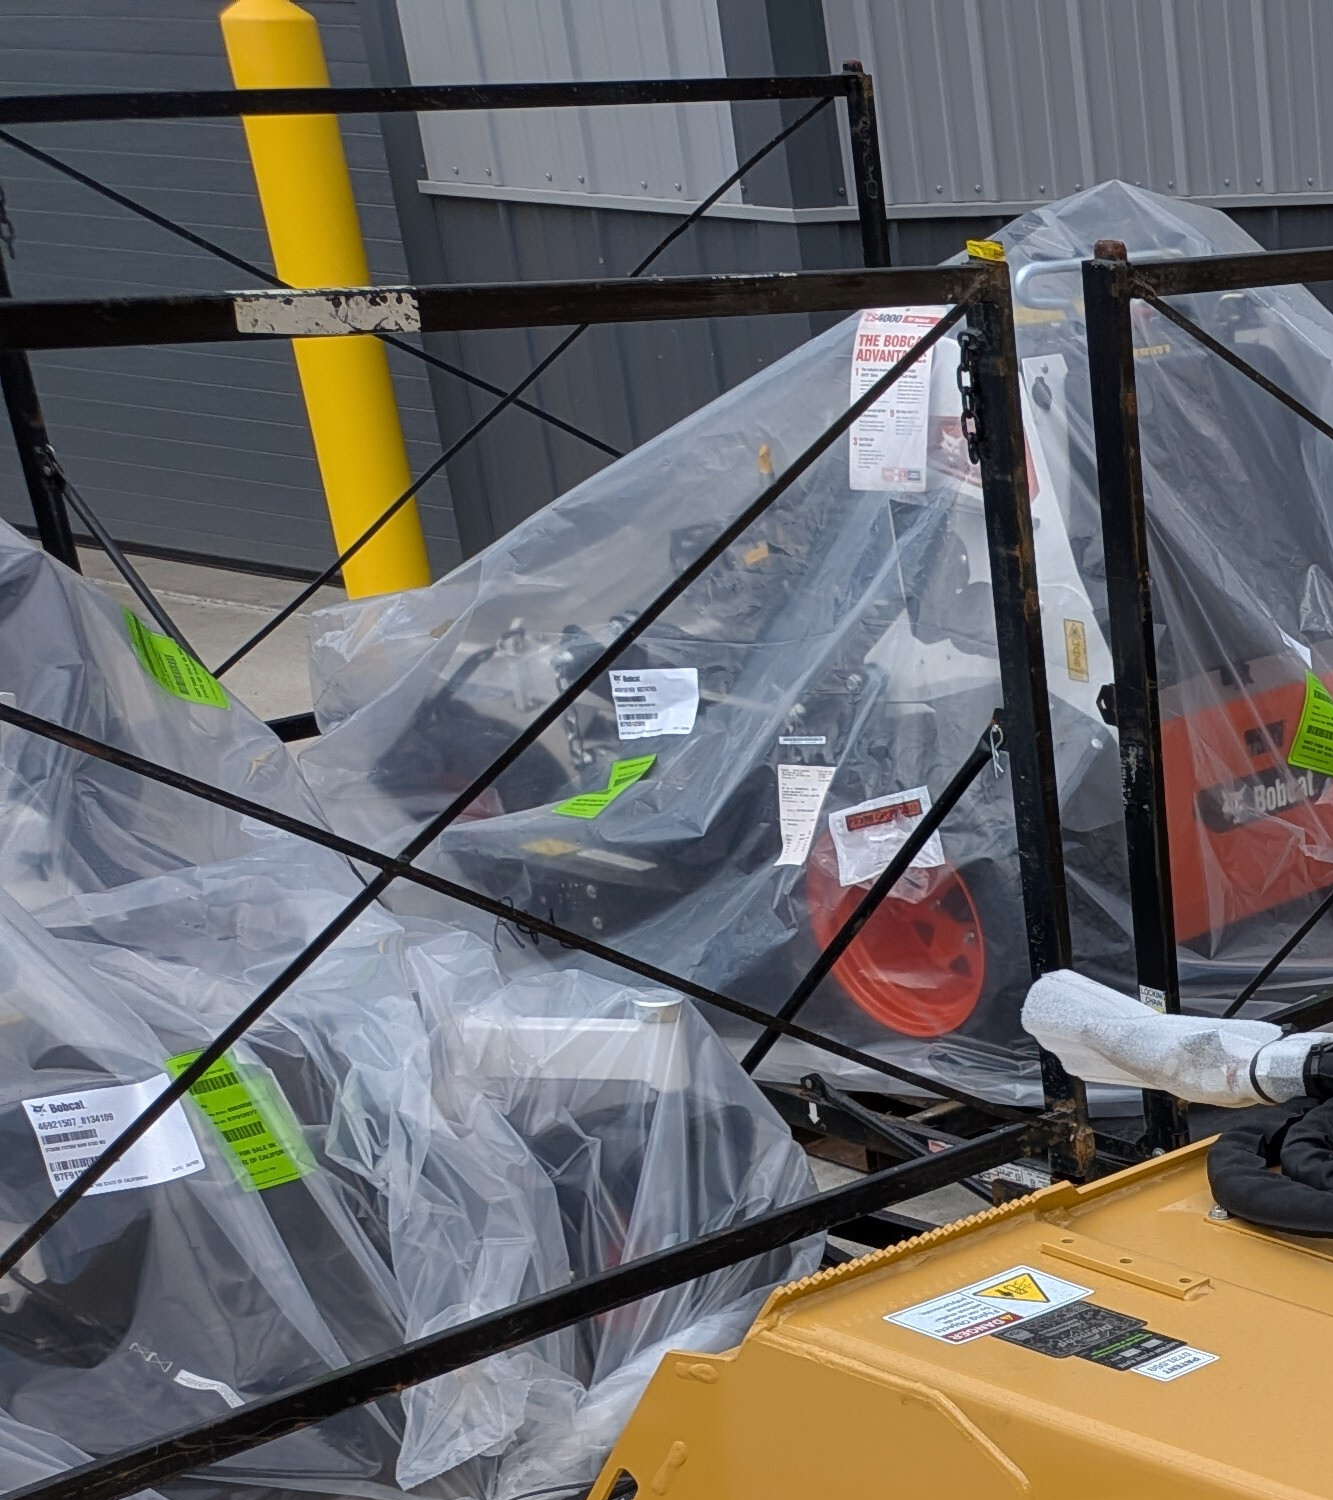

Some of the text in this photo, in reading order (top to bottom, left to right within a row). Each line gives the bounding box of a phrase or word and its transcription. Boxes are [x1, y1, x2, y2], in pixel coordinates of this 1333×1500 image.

[858, 334, 925, 349] THE BOBC
[48, 1100, 86, 1114] Bobcat
[932, 1308, 1001, 1334] Flying Objects
[946, 1317, 1006, 1341] DANGER
[1160, 1356, 1202, 1374] PATENT
